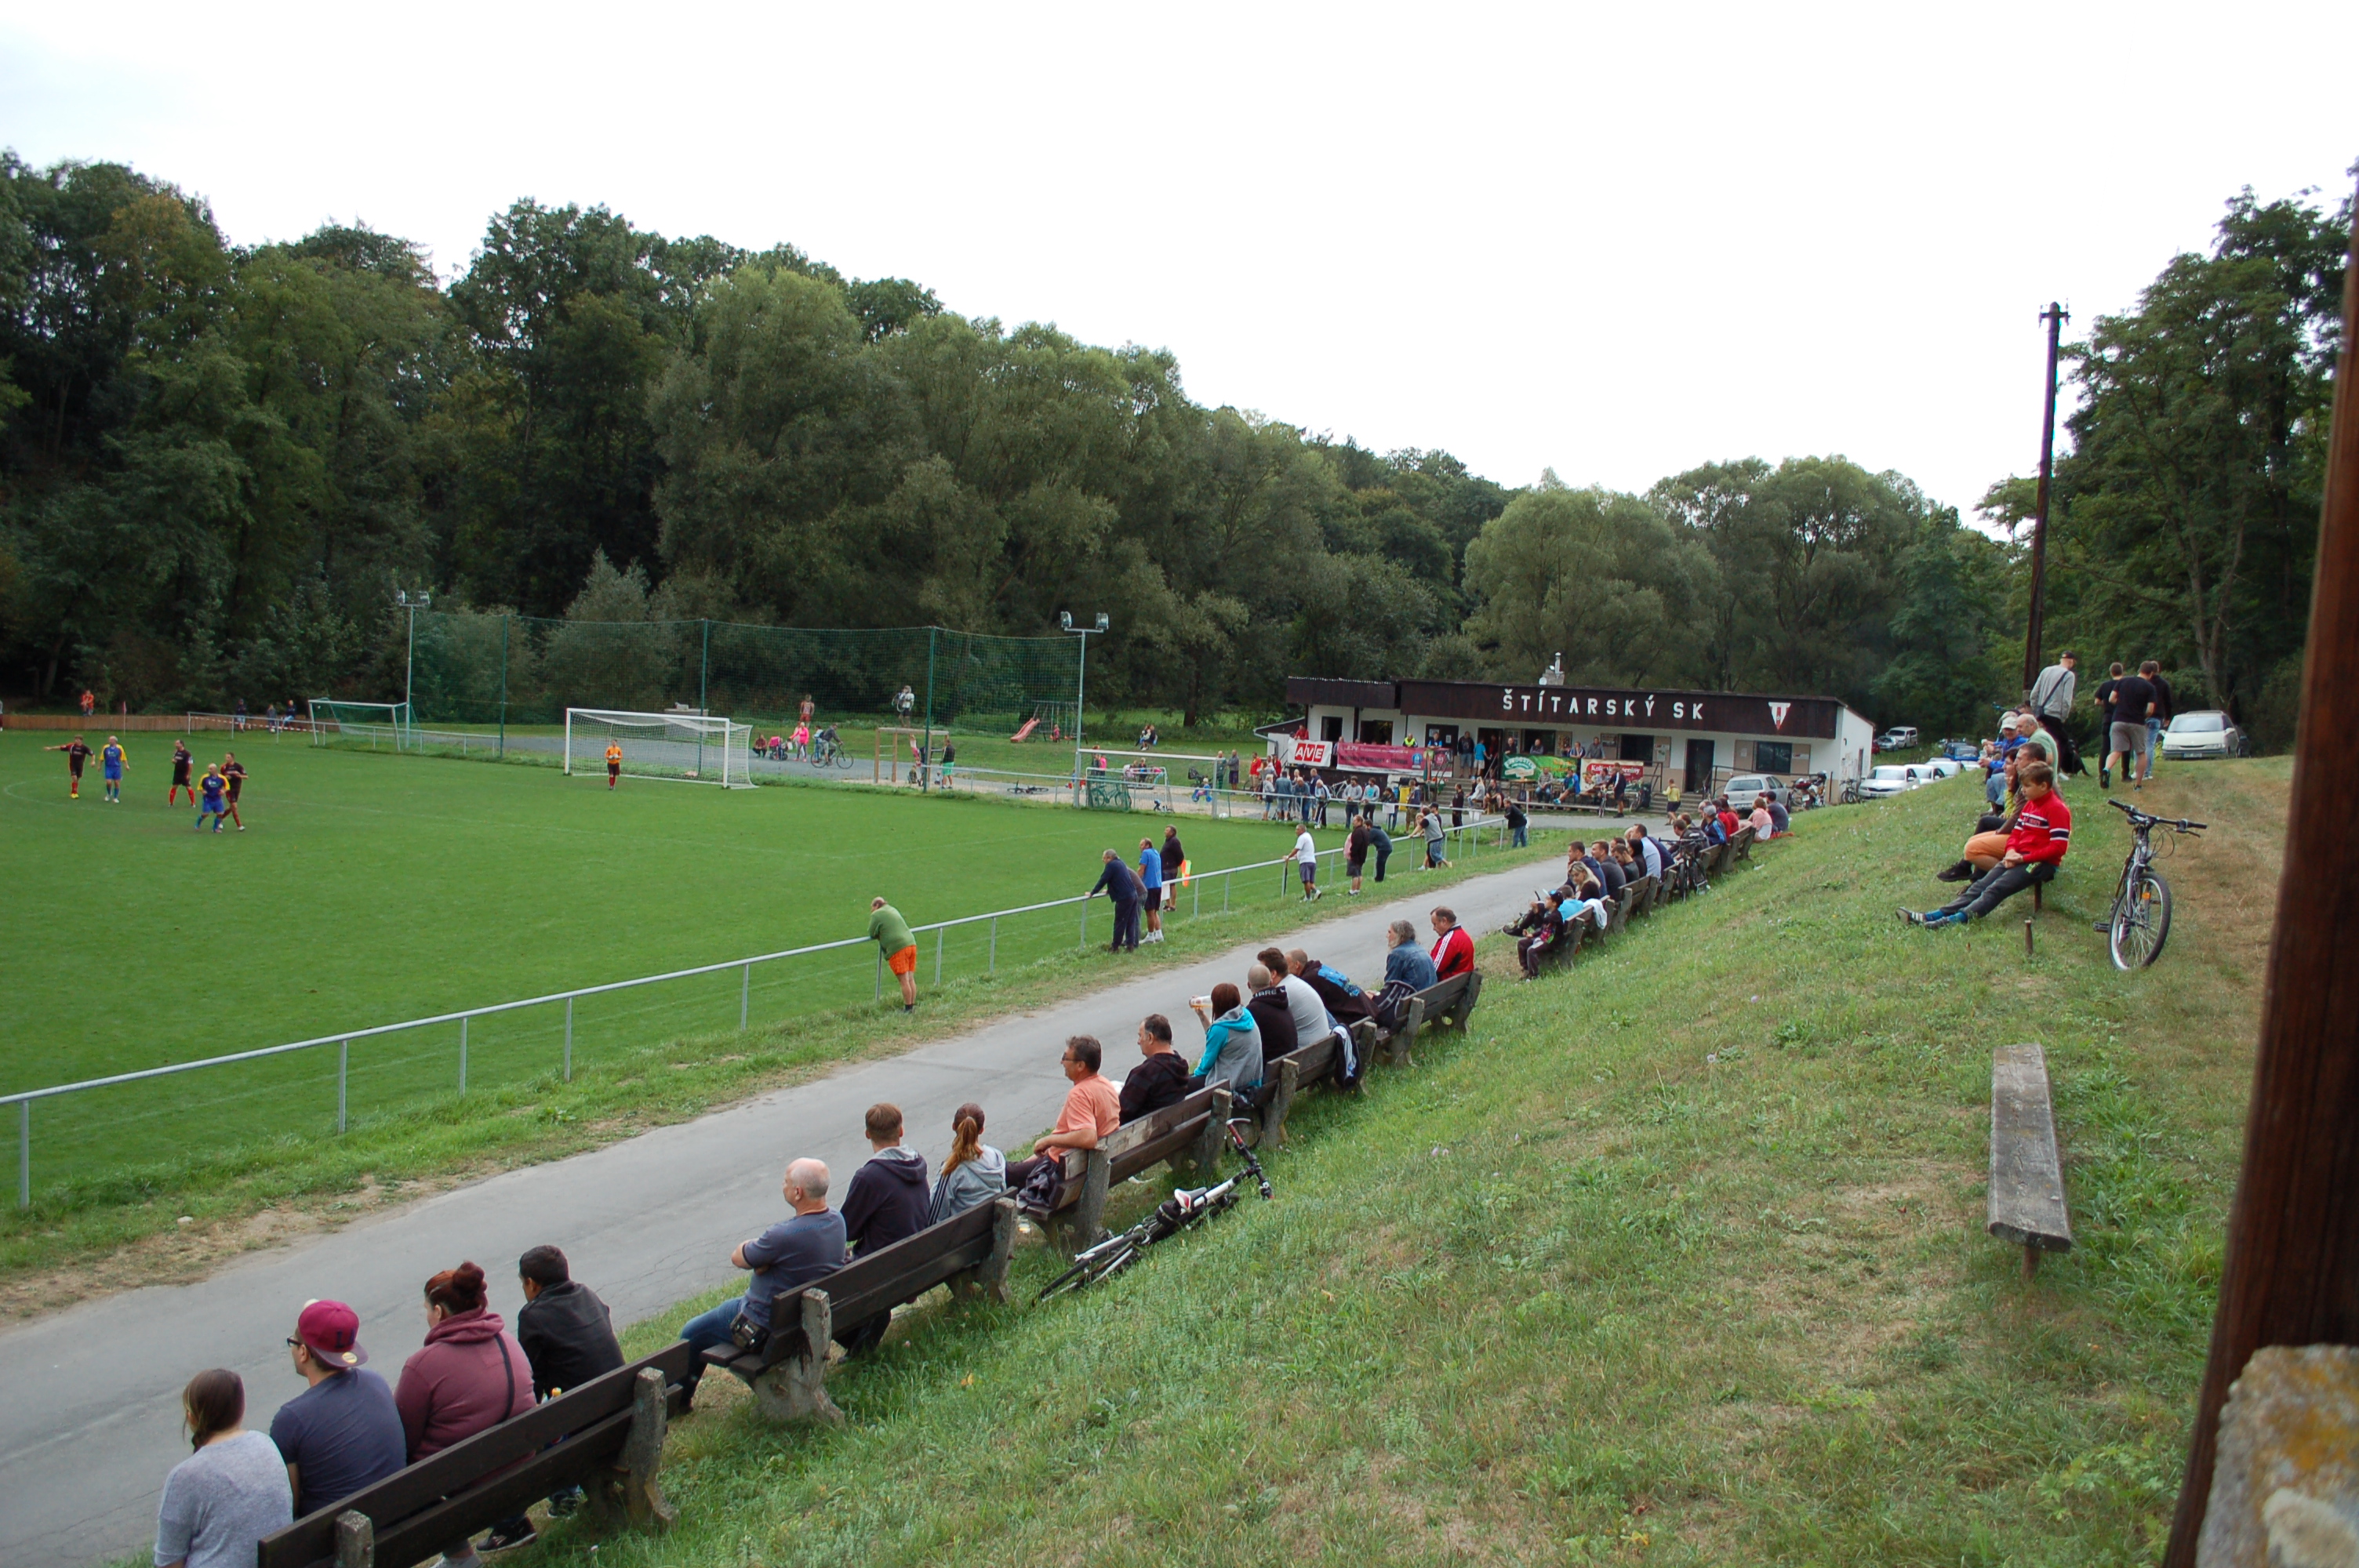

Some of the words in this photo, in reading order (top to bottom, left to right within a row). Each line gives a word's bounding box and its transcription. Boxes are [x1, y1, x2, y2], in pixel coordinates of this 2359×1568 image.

[1503, 688, 1655, 717] ŠTÍTARSKÝ
[1673, 702, 1703, 720] SK
[1295, 746, 1324, 760] AVE
